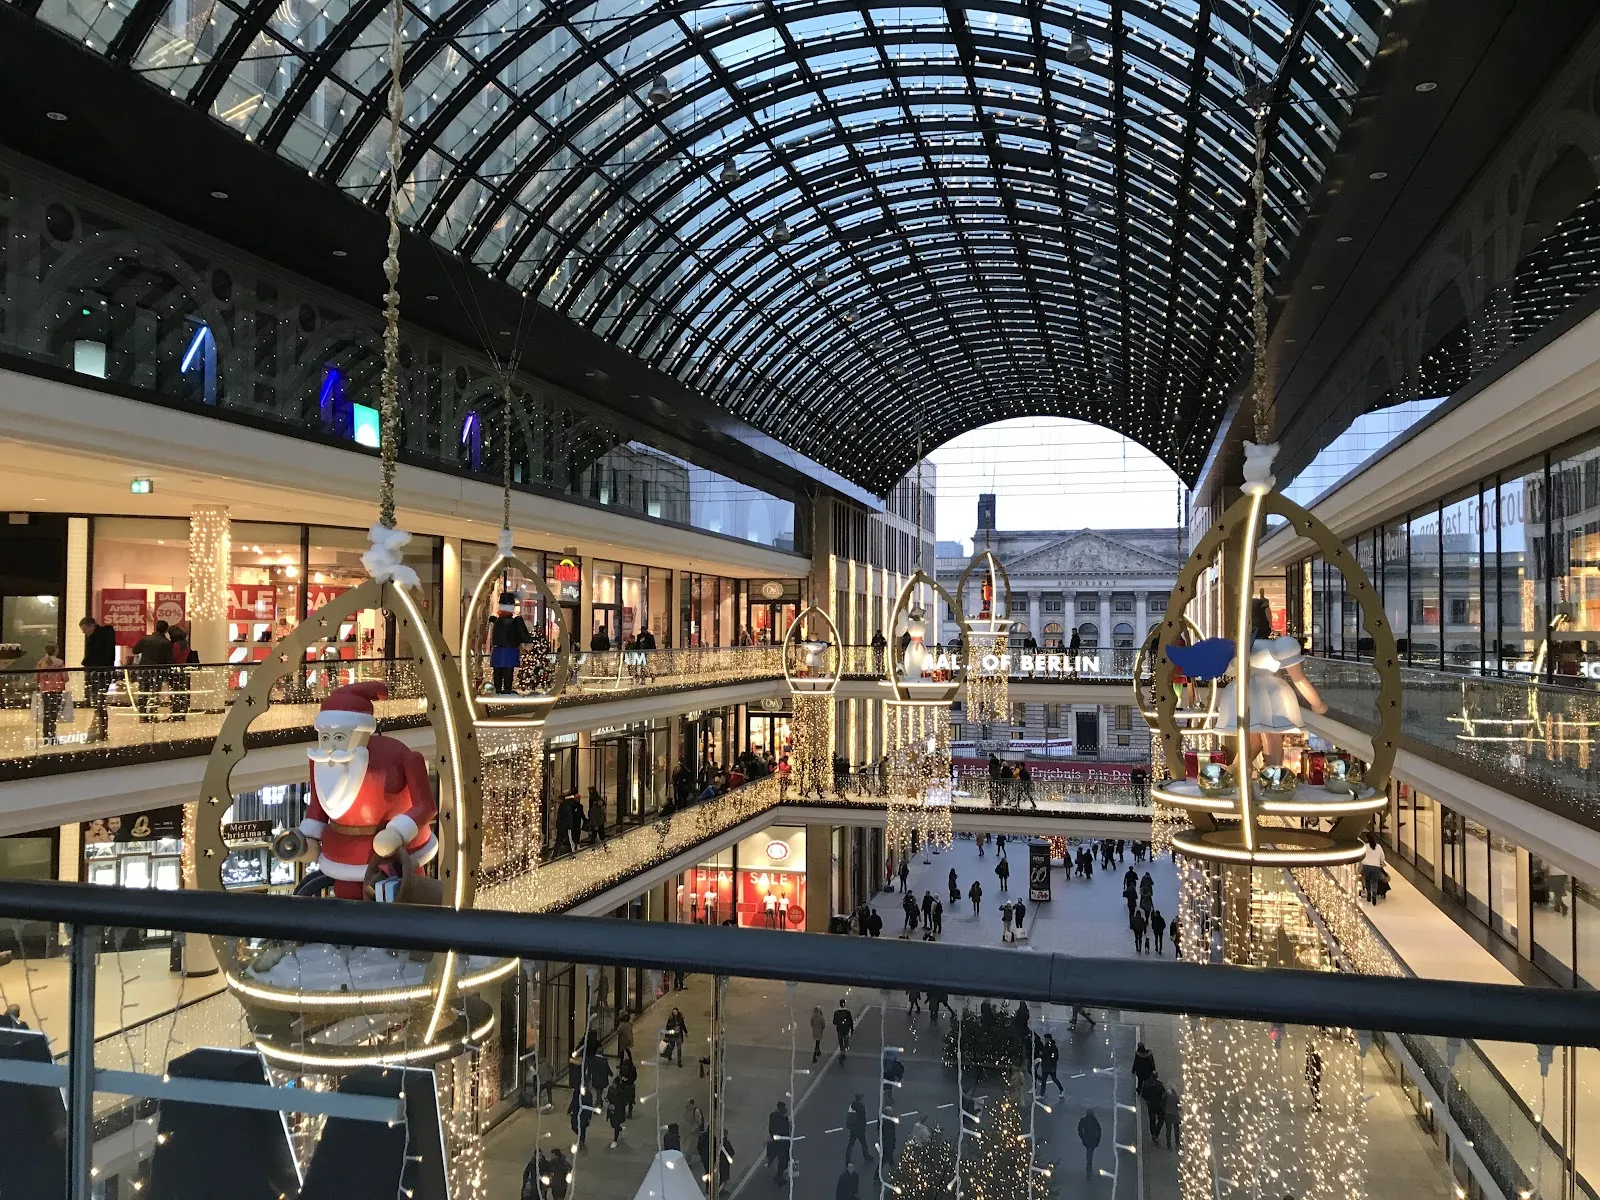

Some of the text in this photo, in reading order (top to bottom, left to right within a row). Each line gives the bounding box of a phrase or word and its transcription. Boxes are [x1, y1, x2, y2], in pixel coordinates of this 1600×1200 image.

[226, 589, 274, 610] ALE
[109, 604, 140, 612] Artikel
[157, 609, 182, 617] 30%
[103, 612, 145, 624] stark
[114, 624, 145, 632] duziert
[921, 653, 1100, 672] MAL OF BERLIN
[962, 764, 990, 776] Länd
[230, 823, 258, 831] Merry
[222, 830, 267, 840] Christmas
[750, 872, 788, 886] SALE
